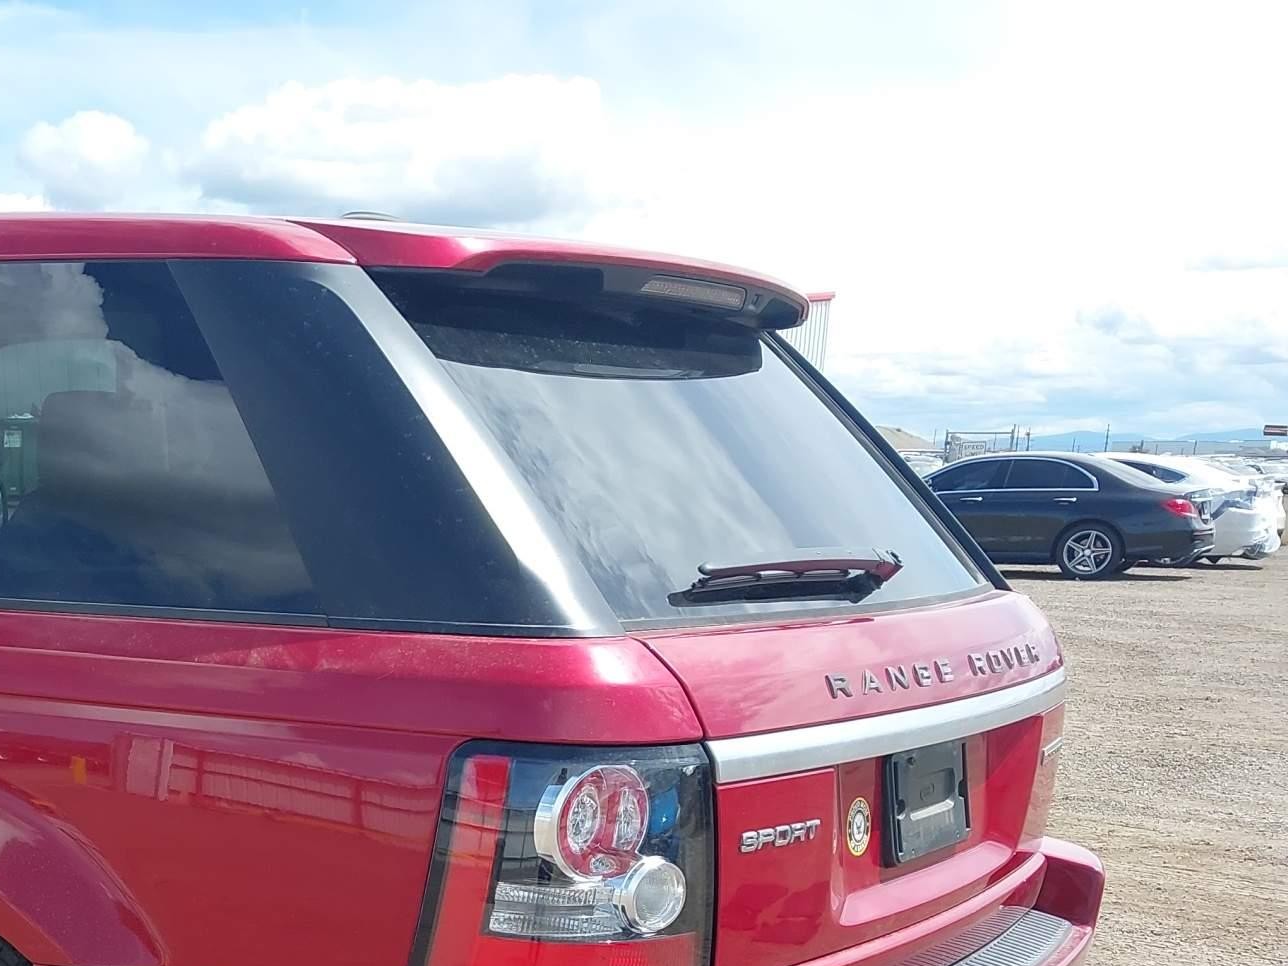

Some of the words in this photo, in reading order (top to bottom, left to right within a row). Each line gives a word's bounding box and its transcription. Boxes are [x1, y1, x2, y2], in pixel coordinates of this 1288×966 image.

[824, 658, 954, 699] RANGE
[967, 643, 1040, 676] ROVER
[739, 819, 821, 853] SPORT
